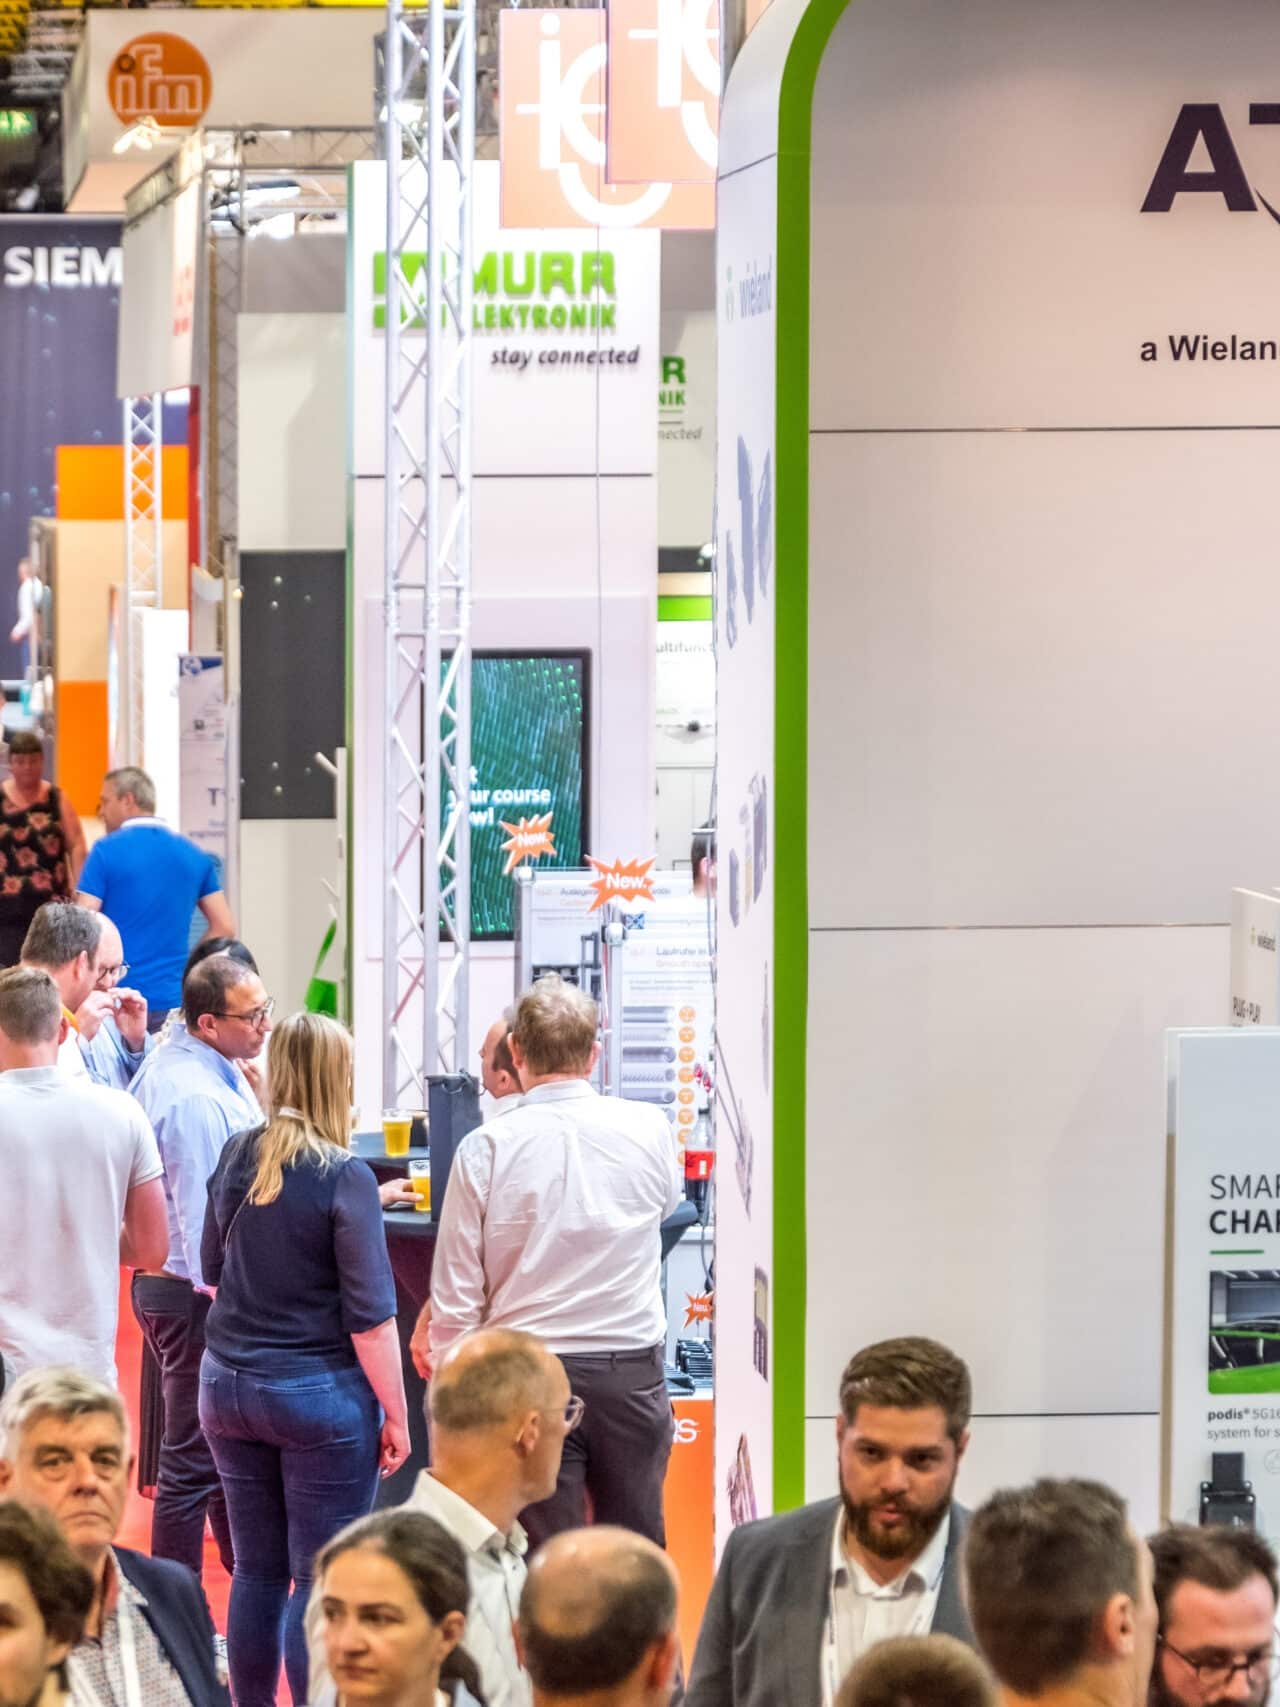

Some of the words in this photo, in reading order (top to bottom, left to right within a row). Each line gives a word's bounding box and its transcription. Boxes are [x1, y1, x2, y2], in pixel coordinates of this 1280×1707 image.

[115, 43, 202, 113] ifm
[3, 246, 122, 287] SIEM
[491, 346, 532, 370] stay
[538, 345, 640, 365] connected
[1140, 341, 1157, 361] a
[1168, 334, 1280, 361] Wielan
[492, 788, 551, 803] course
[605, 872, 647, 889] New.
[1207, 1428, 1251, 1441] system
[1254, 1425, 1270, 1438] for
